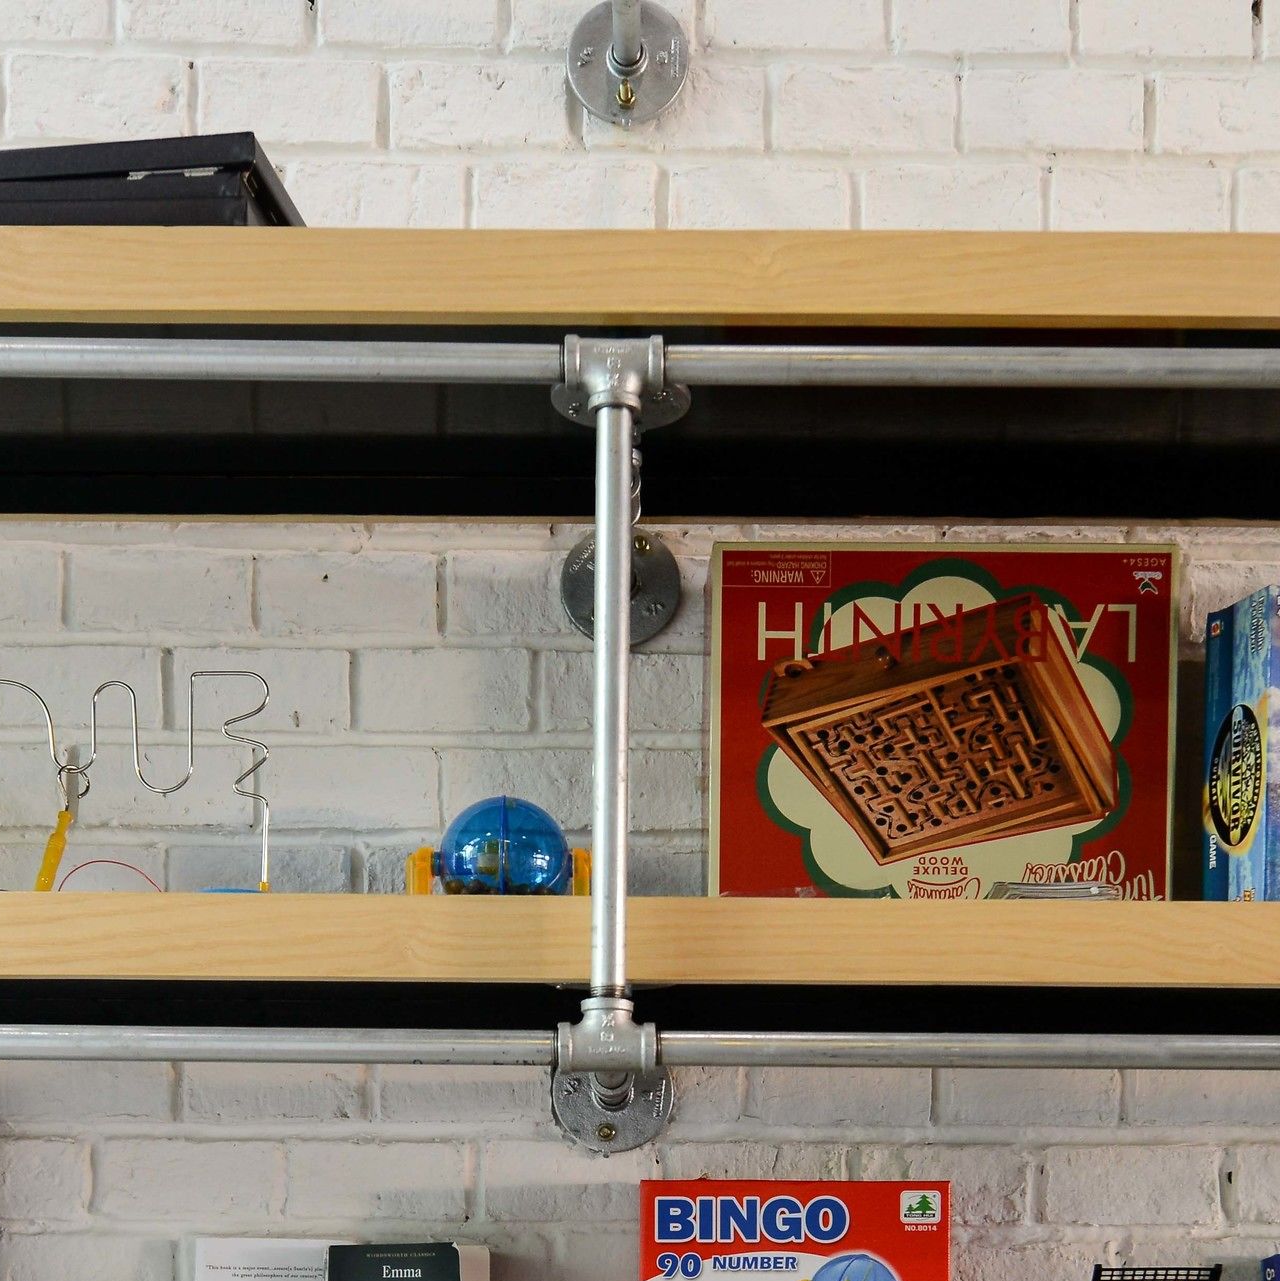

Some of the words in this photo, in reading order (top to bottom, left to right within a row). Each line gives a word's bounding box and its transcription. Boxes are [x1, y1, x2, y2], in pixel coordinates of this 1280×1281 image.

[750, 569, 804, 584] WARNING:
[757, 601, 1138, 663] LABYRINTH
[1230, 719, 1242, 832] SURVIVOR
[918, 856, 964, 866] WOOD
[1208, 833, 1218, 870] GAME
[913, 866, 969, 876] DELUXE
[655, 1196, 850, 1244] BINGO
[381, 1265, 423, 1279] Emma
[657, 1252, 703, 1280] 90
[712, 1255, 799, 1271] NUMBER
